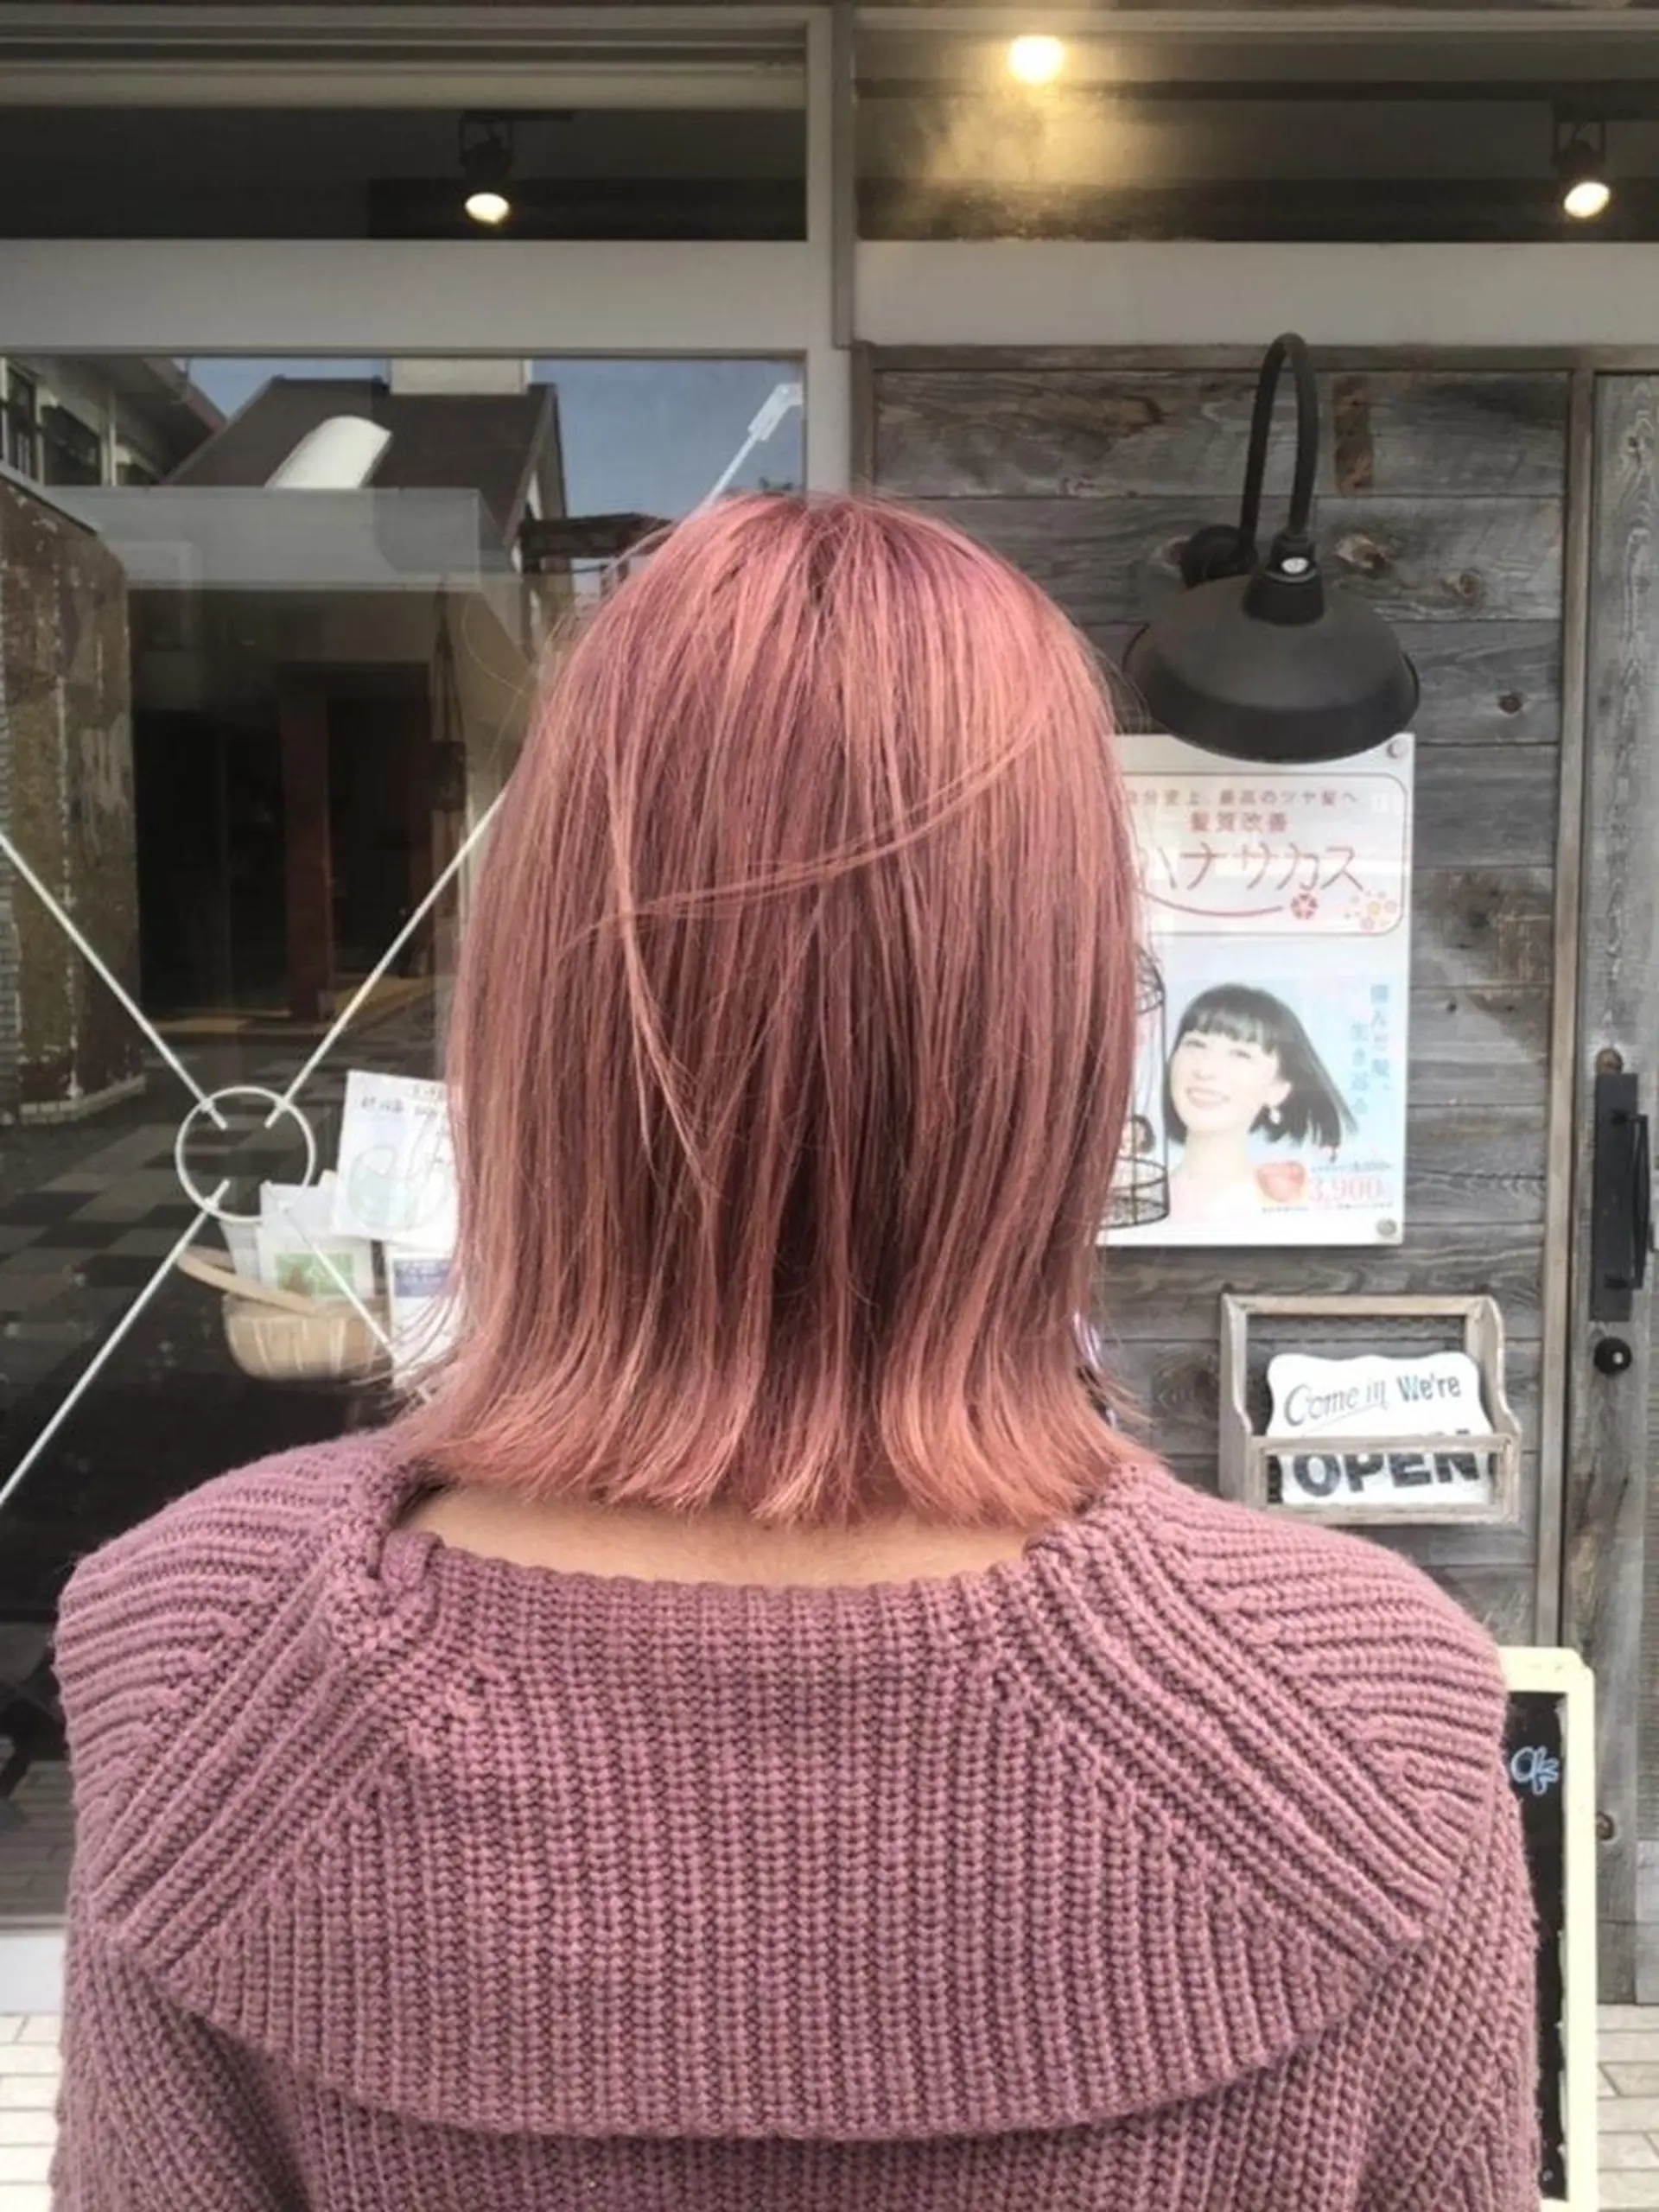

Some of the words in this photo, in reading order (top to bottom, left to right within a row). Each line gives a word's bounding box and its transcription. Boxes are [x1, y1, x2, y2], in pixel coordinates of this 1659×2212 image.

[1283, 1382, 1359, 1427] Come
[1395, 1372, 1462, 1403] We're
[1294, 1430, 1480, 1497] OPEN
